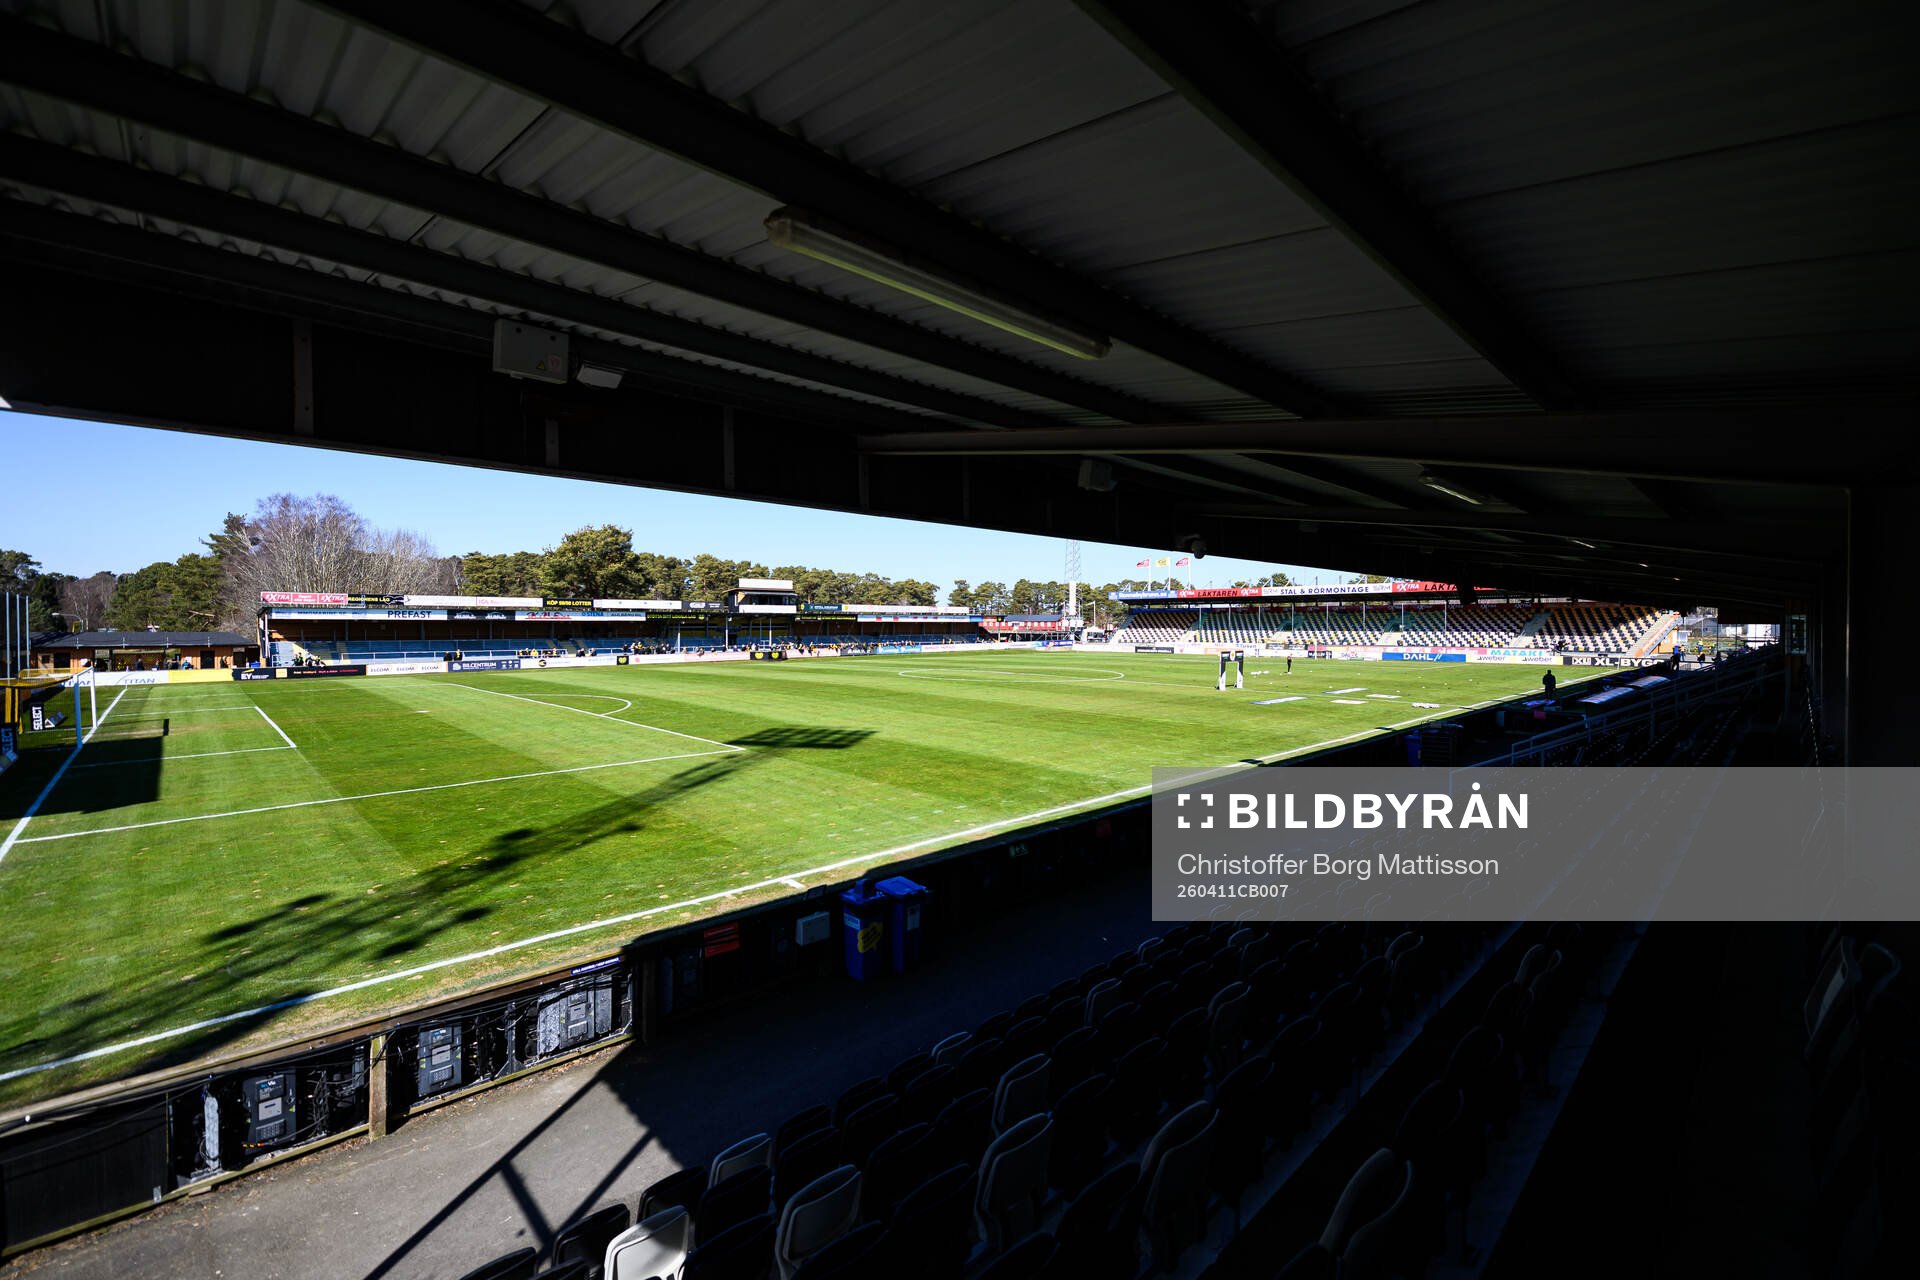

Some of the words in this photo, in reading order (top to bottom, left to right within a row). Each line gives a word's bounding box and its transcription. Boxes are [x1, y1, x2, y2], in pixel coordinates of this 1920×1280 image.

[1308, 586, 1369, 594] RÖRMONTAGE
[387, 610, 432, 619] PREFAST
[32, 706, 43, 730] SELECT
